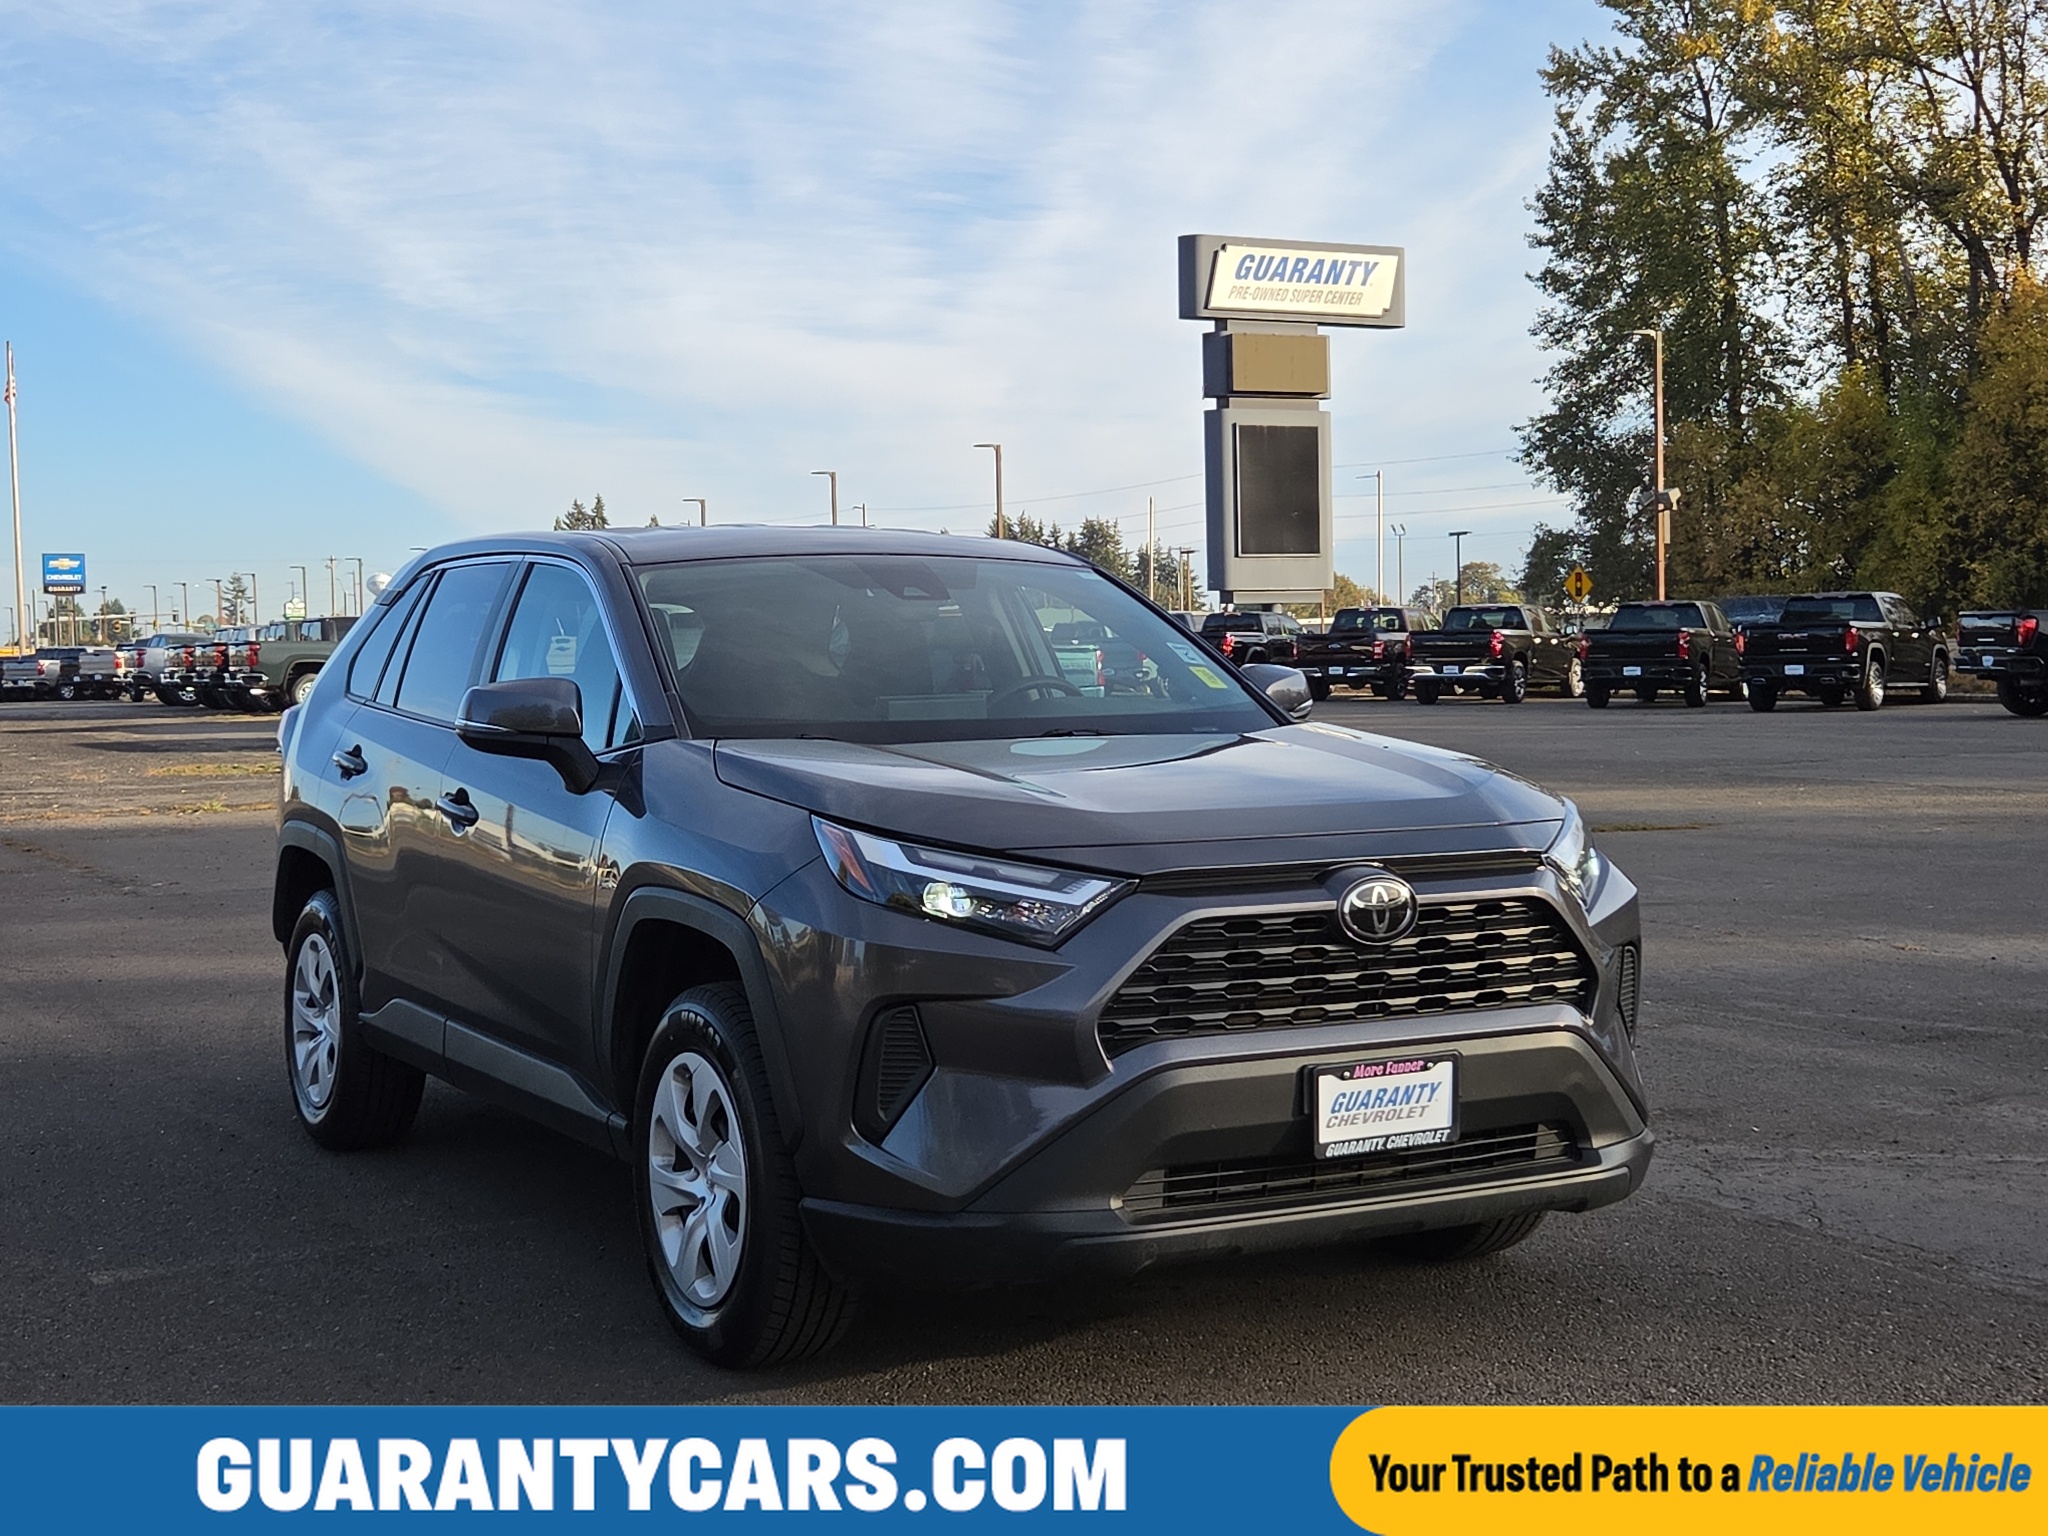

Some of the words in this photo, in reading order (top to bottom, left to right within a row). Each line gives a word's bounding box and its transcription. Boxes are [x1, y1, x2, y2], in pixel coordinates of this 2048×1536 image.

[1234, 254, 1380, 287] GUARANTY
[1228, 285, 1289, 302] PRE-OWNED
[1289, 288, 1324, 304] SUPER
[1324, 291, 1364, 306] CENTER
[1353, 1063, 1383, 1078] More
[1386, 1060, 1424, 1075] Funner
[1330, 1081, 1442, 1115] GUARANTY
[1325, 1105, 1429, 1129] CHEVROLET
[1325, 1137, 1384, 1158] GUARANTY
[1386, 1129, 1451, 1150] CHEVROLET
